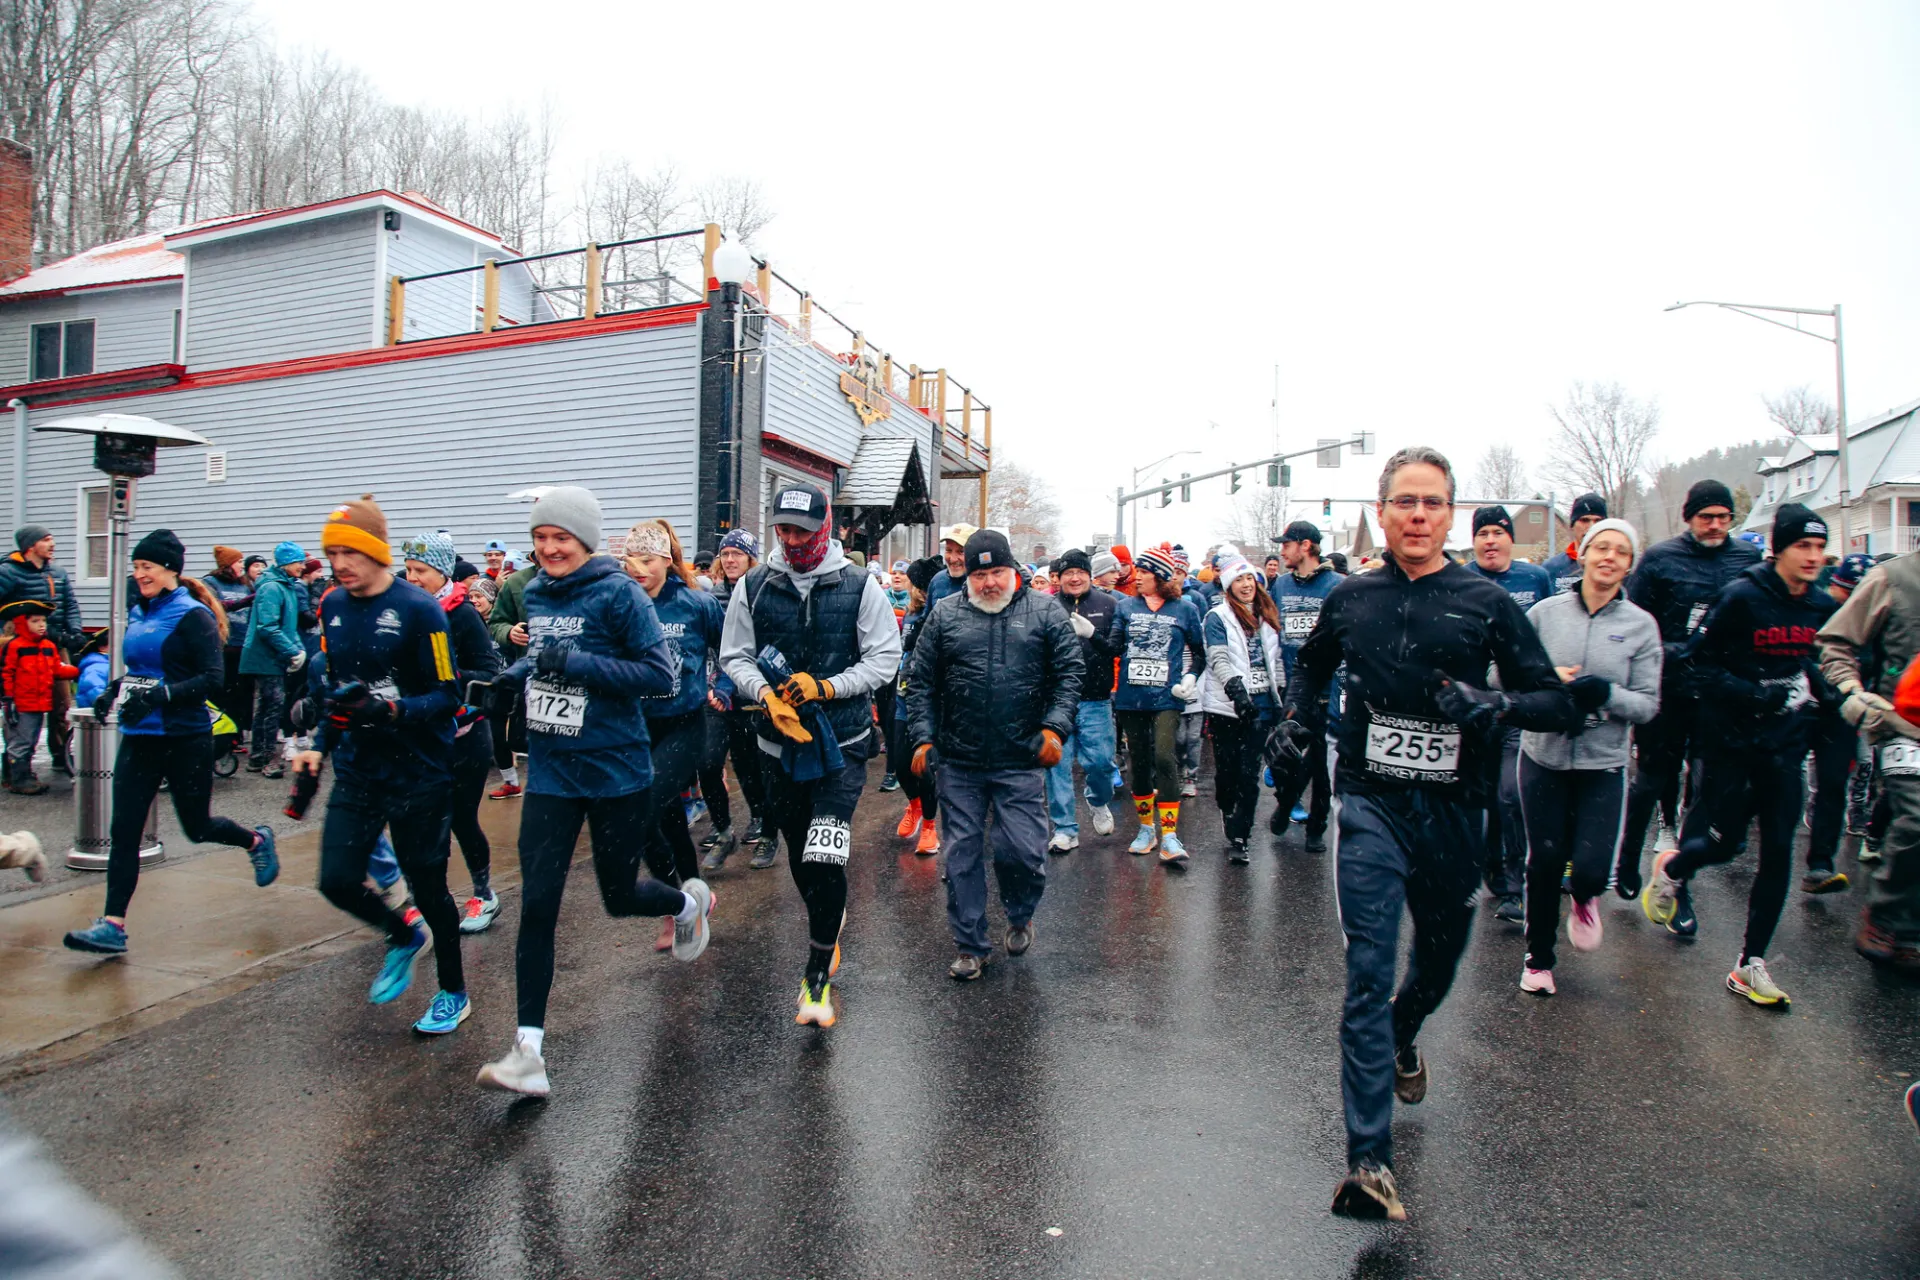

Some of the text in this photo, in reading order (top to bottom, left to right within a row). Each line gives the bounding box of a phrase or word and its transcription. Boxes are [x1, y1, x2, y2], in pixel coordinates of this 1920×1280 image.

[1292, 617, 1314, 629] 053
[1136, 664, 1161, 677] 257
[1251, 673, 1265, 685] 54
[560, 685, 585, 696] LAKE
[537, 694, 570, 718] 172
[526, 719, 581, 737] URKEY TROT
[1371, 713, 1460, 733] SARANAC LAKE
[1385, 731, 1444, 763] 255
[1365, 760, 1457, 782] TURKEY TROT
[811, 817, 836, 826] RANAC
[808, 828, 844, 849] 286
[830, 855, 848, 866] TROT
